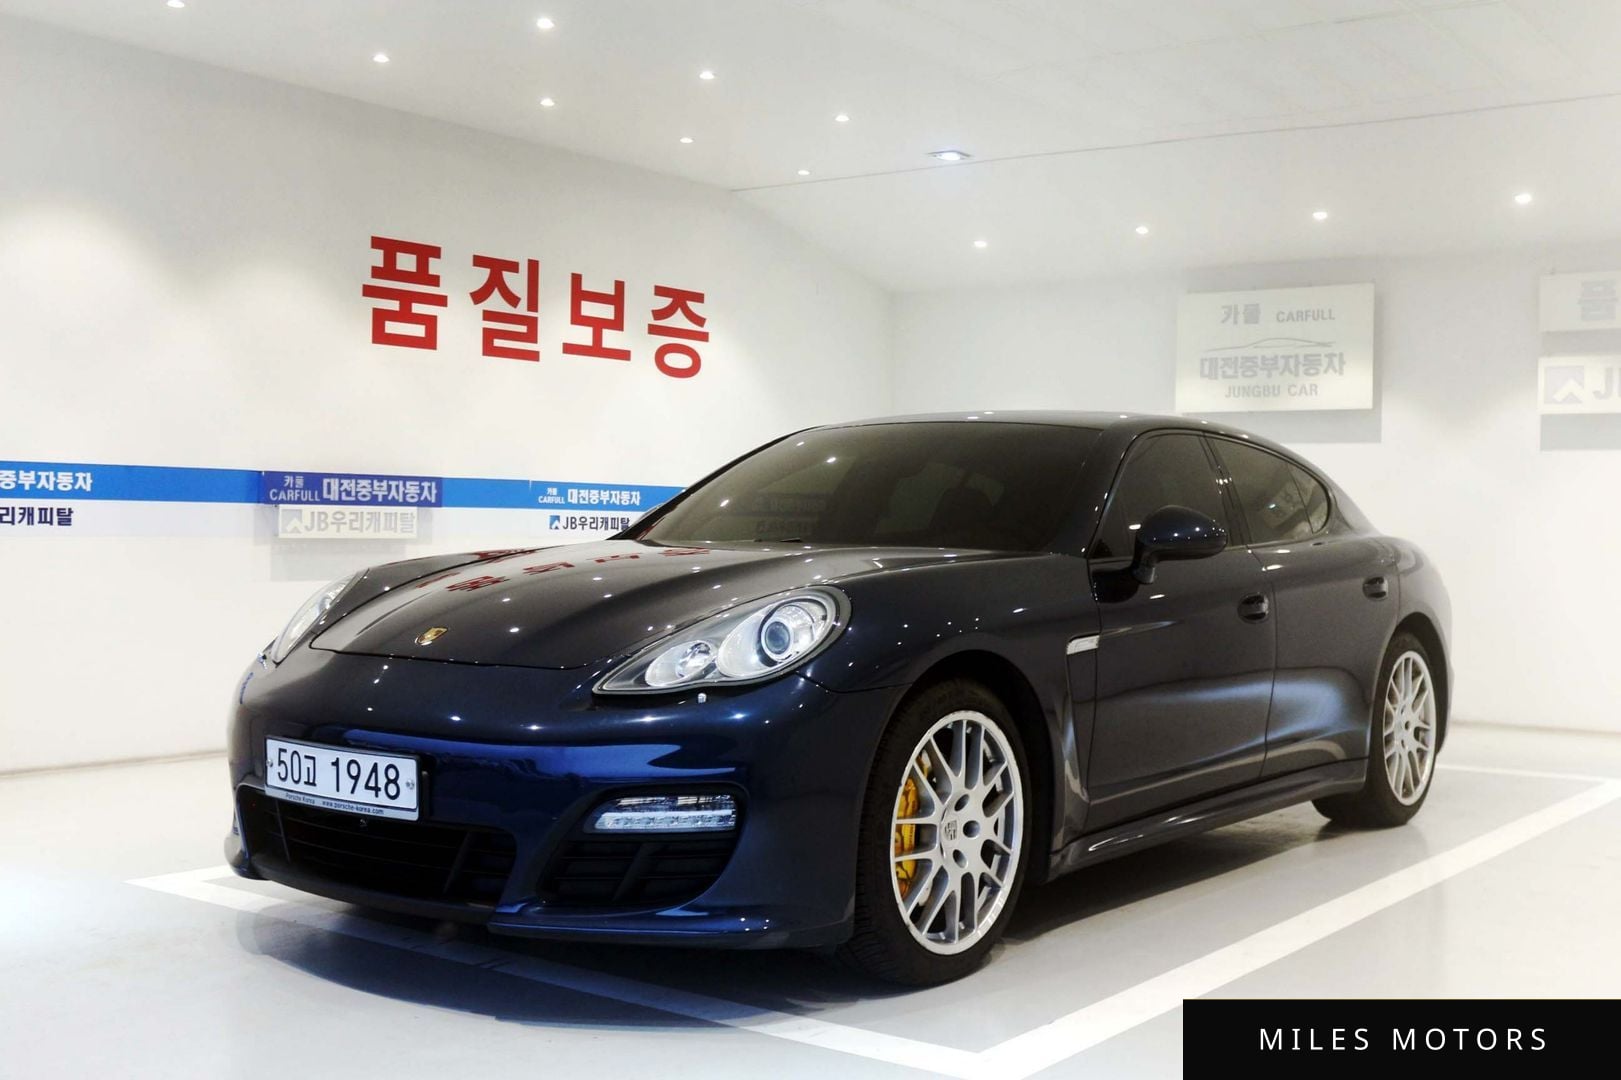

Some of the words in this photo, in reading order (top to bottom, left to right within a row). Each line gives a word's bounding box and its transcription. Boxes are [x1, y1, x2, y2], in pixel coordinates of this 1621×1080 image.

[362, 235, 709, 378] 품질보증
[1276, 308, 1336, 323] CARFULL
[1199, 351, 1346, 380] 대전중부자동차
[1224, 383, 1281, 398] JUNGBU
[1287, 382, 1319, 397] CAR
[1592, 367, 1621, 400] J
[0, 470, 93, 492] 중부자동차
[269, 488, 320, 502] CARFULL
[322, 477, 437, 503] 대전중부자동차
[567, 488, 641, 506] 대전중부자동차
[0, 506, 74, 526] 리캐피탈
[304, 511, 416, 534] JB우리캐피탈
[563, 515, 630, 532] JB우리캐피탈
[277, 747, 317, 787] 50고
[331, 756, 401, 801] 1948
